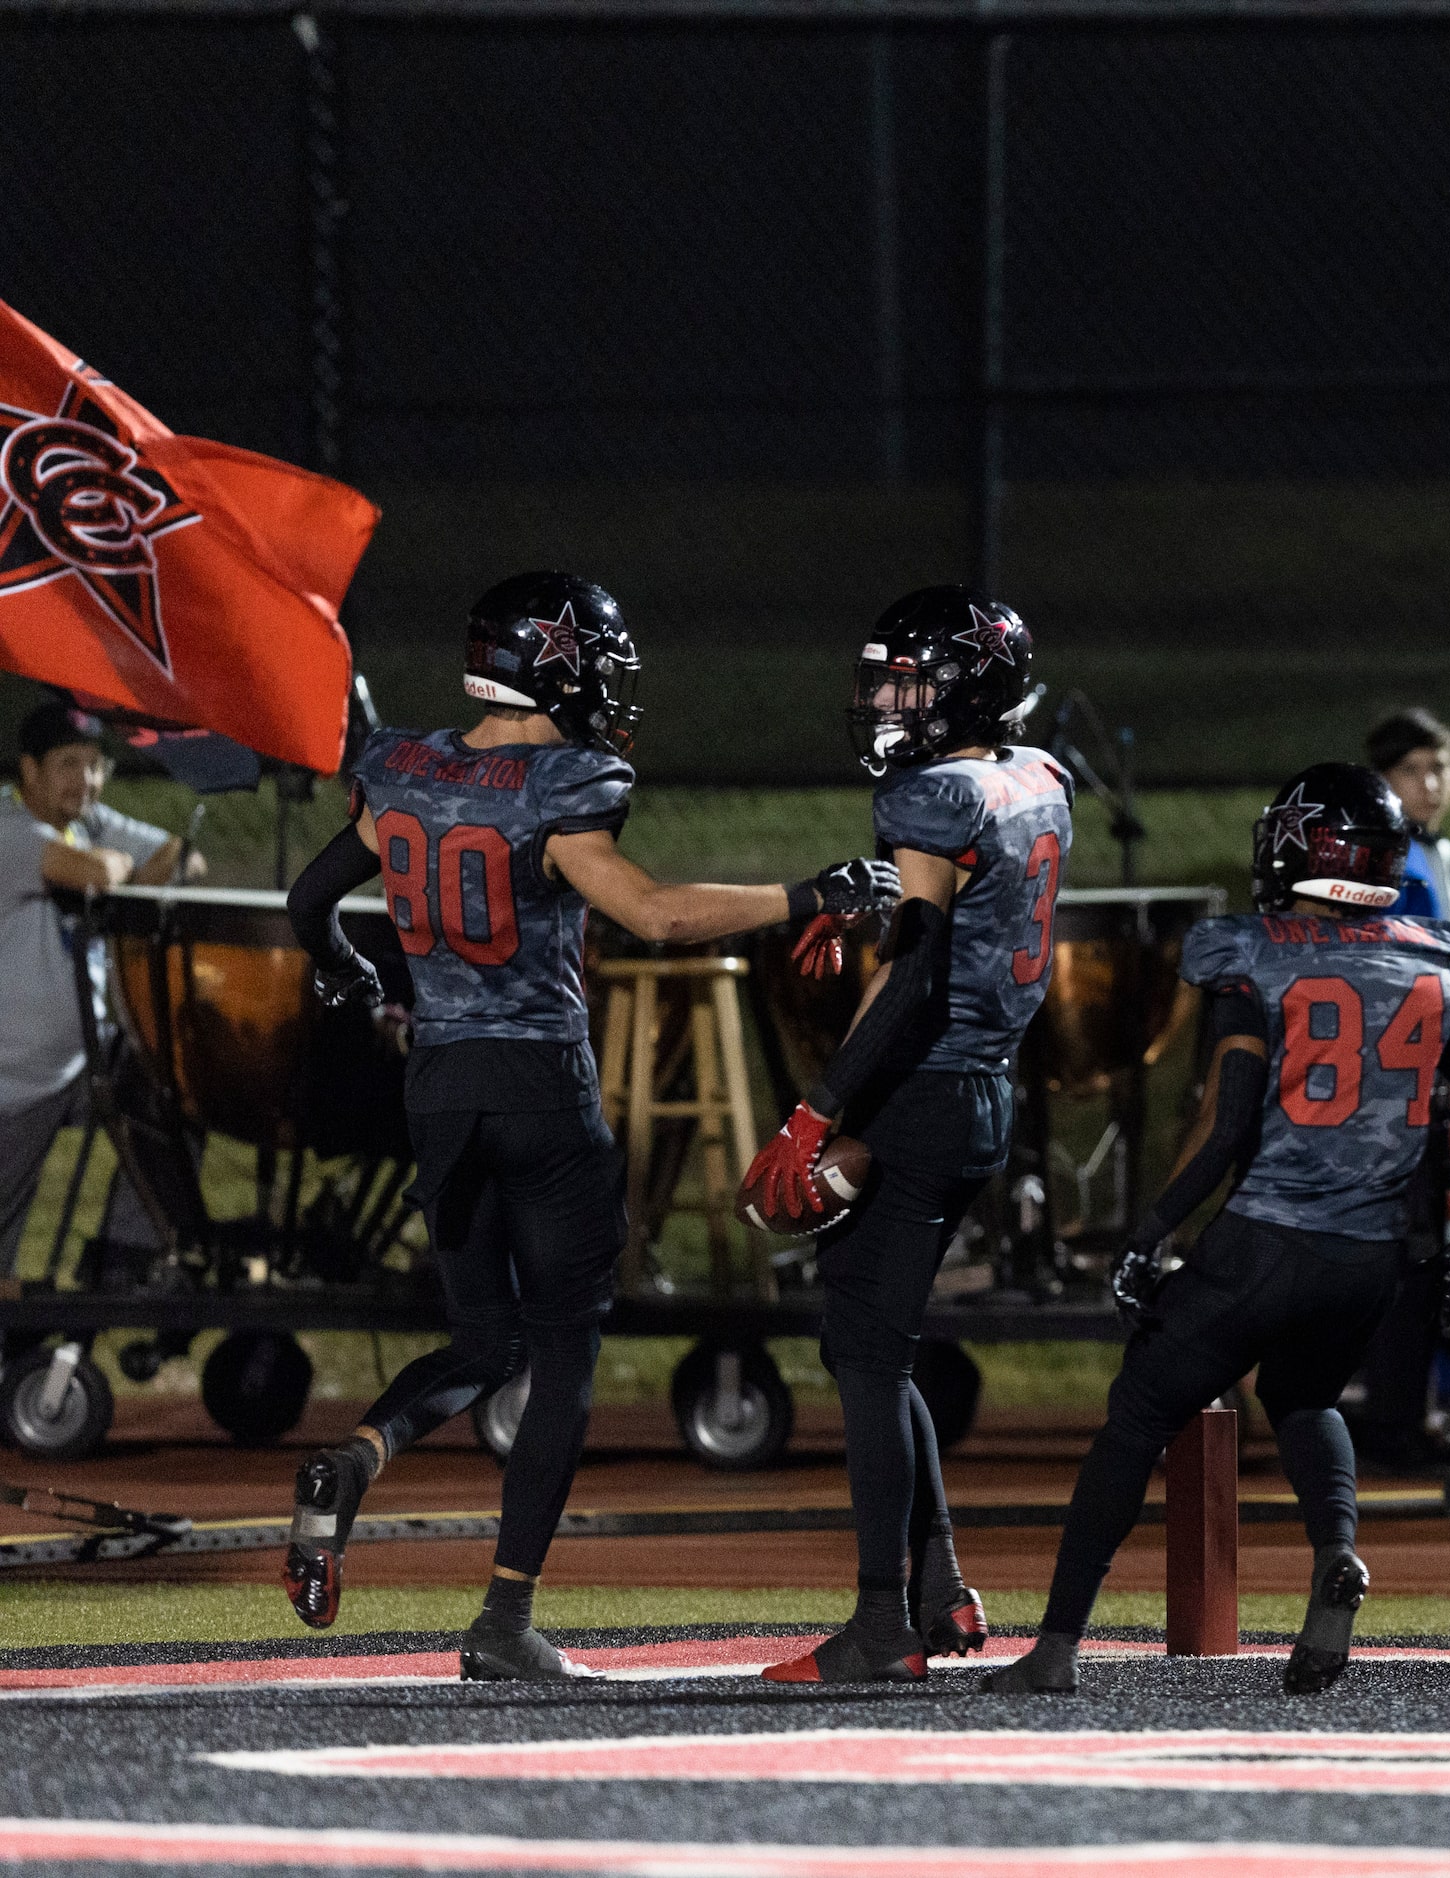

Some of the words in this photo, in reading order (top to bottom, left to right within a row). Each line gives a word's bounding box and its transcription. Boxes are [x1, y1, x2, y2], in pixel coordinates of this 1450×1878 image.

[384, 741, 442, 776] ONE
[376, 810, 519, 966] 80
[1011, 832, 1061, 985] 3
[1280, 975, 1444, 1127] 84
